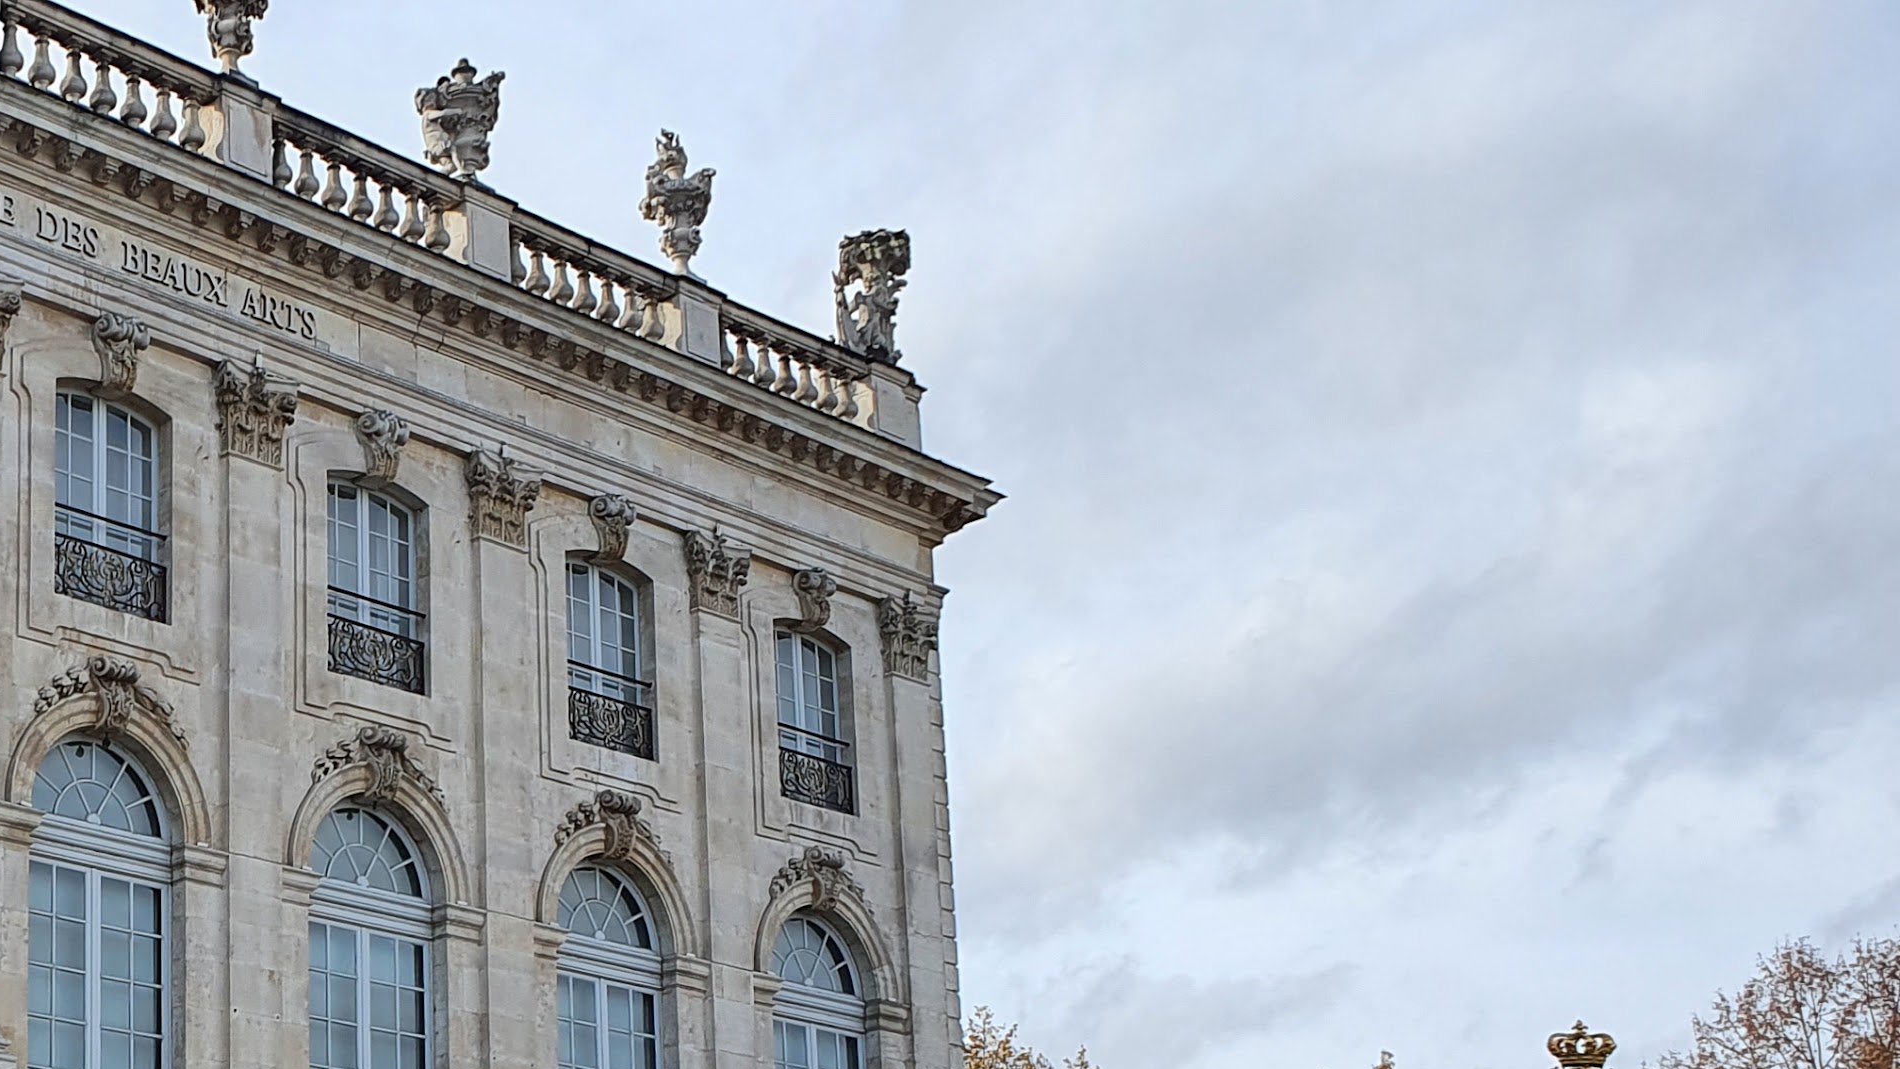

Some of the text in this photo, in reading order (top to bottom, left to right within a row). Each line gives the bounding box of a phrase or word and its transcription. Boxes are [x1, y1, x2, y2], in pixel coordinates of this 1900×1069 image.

[35, 205, 100, 259] DES
[120, 240, 229, 308] BEAUX
[240, 285, 318, 341] ARTS
